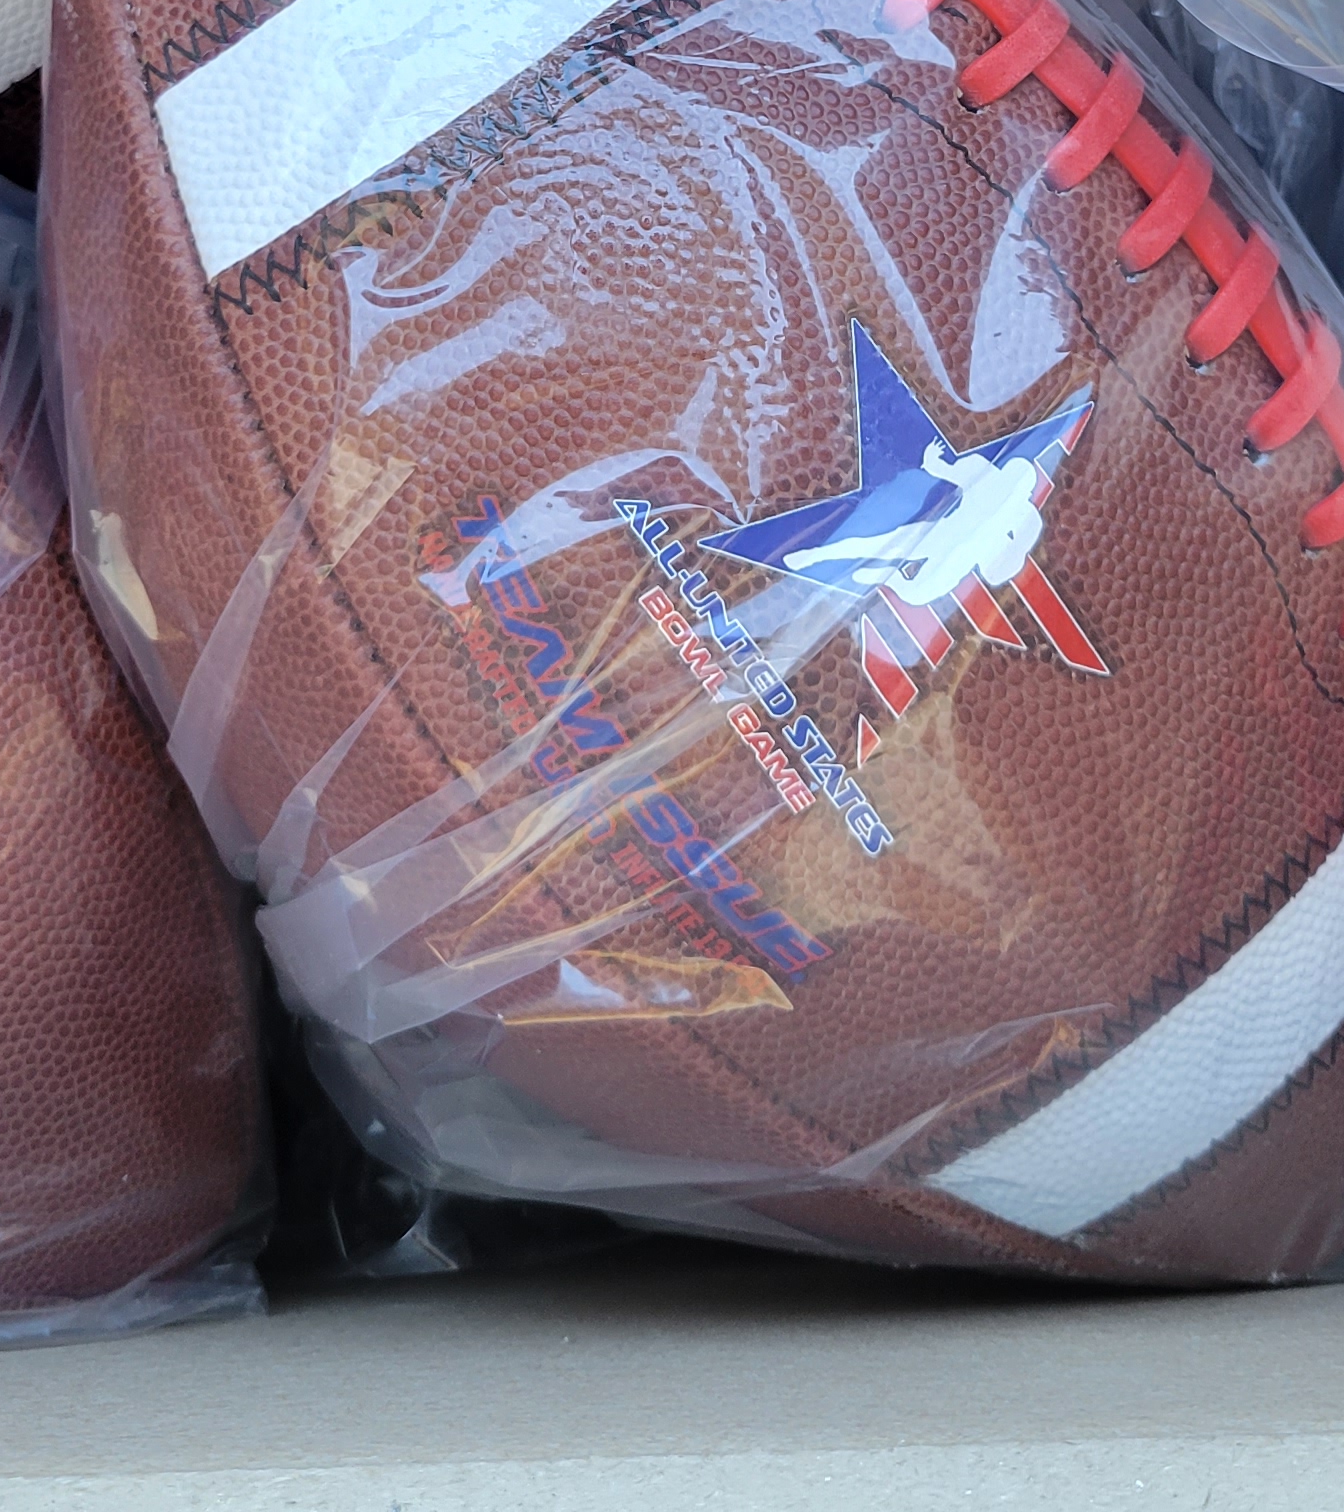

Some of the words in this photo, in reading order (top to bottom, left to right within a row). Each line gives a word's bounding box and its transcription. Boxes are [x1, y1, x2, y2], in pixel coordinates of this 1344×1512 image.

[419, 531, 540, 735] HARAFTED
[452, 495, 631, 755] TEAM
[613, 498, 797, 719] ALL-UNITED
[782, 714, 894, 858] STATES
[638, 586, 728, 702] BOWL
[727, 703, 816, 814] GAME
